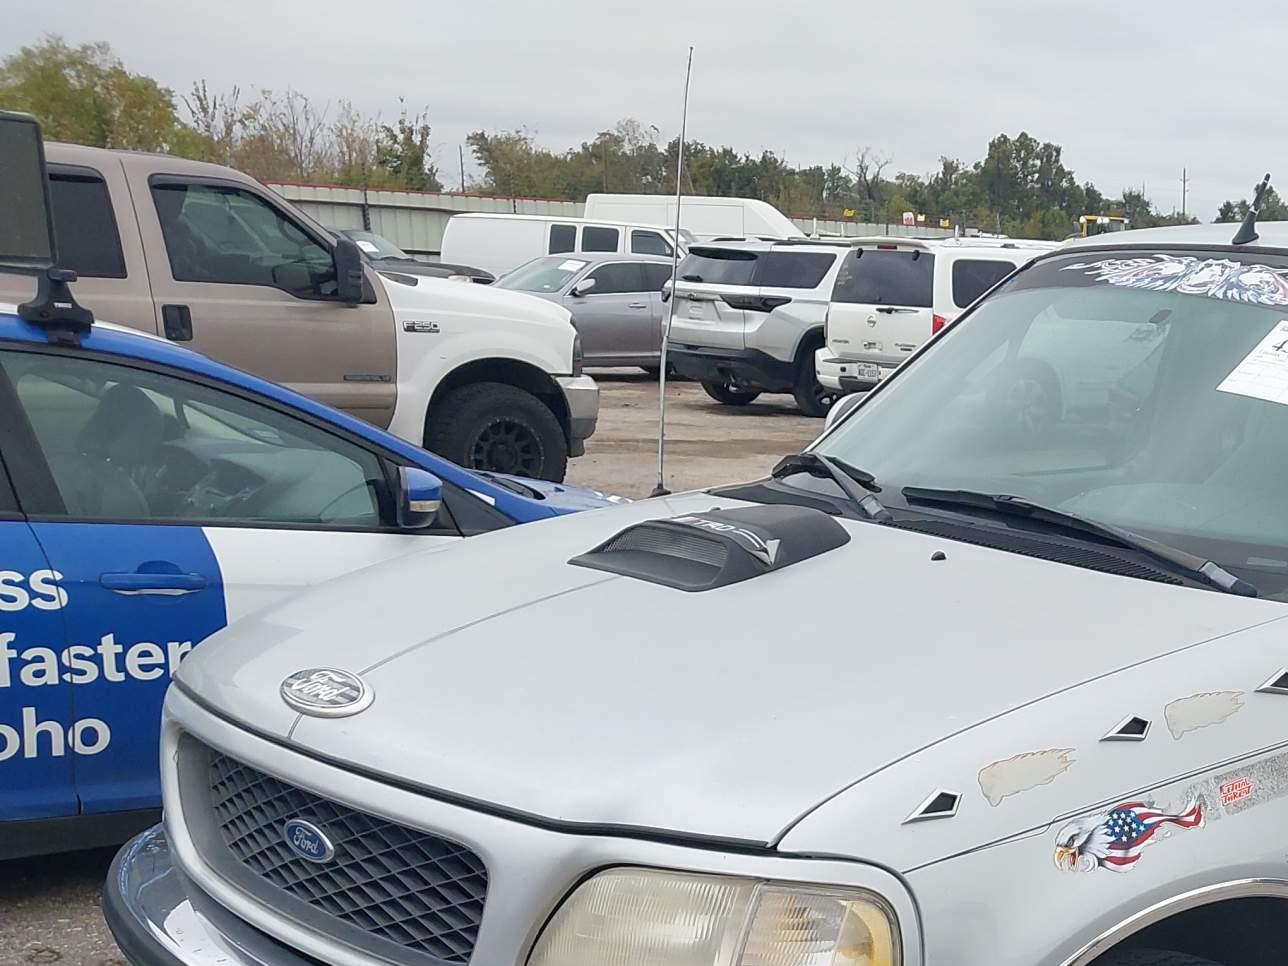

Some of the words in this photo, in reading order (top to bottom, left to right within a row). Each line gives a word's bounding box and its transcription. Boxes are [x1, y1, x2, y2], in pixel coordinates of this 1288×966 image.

[0, 631, 193, 688] faster
[291, 670, 350, 701] Ford
[293, 826, 319, 855] Ford
